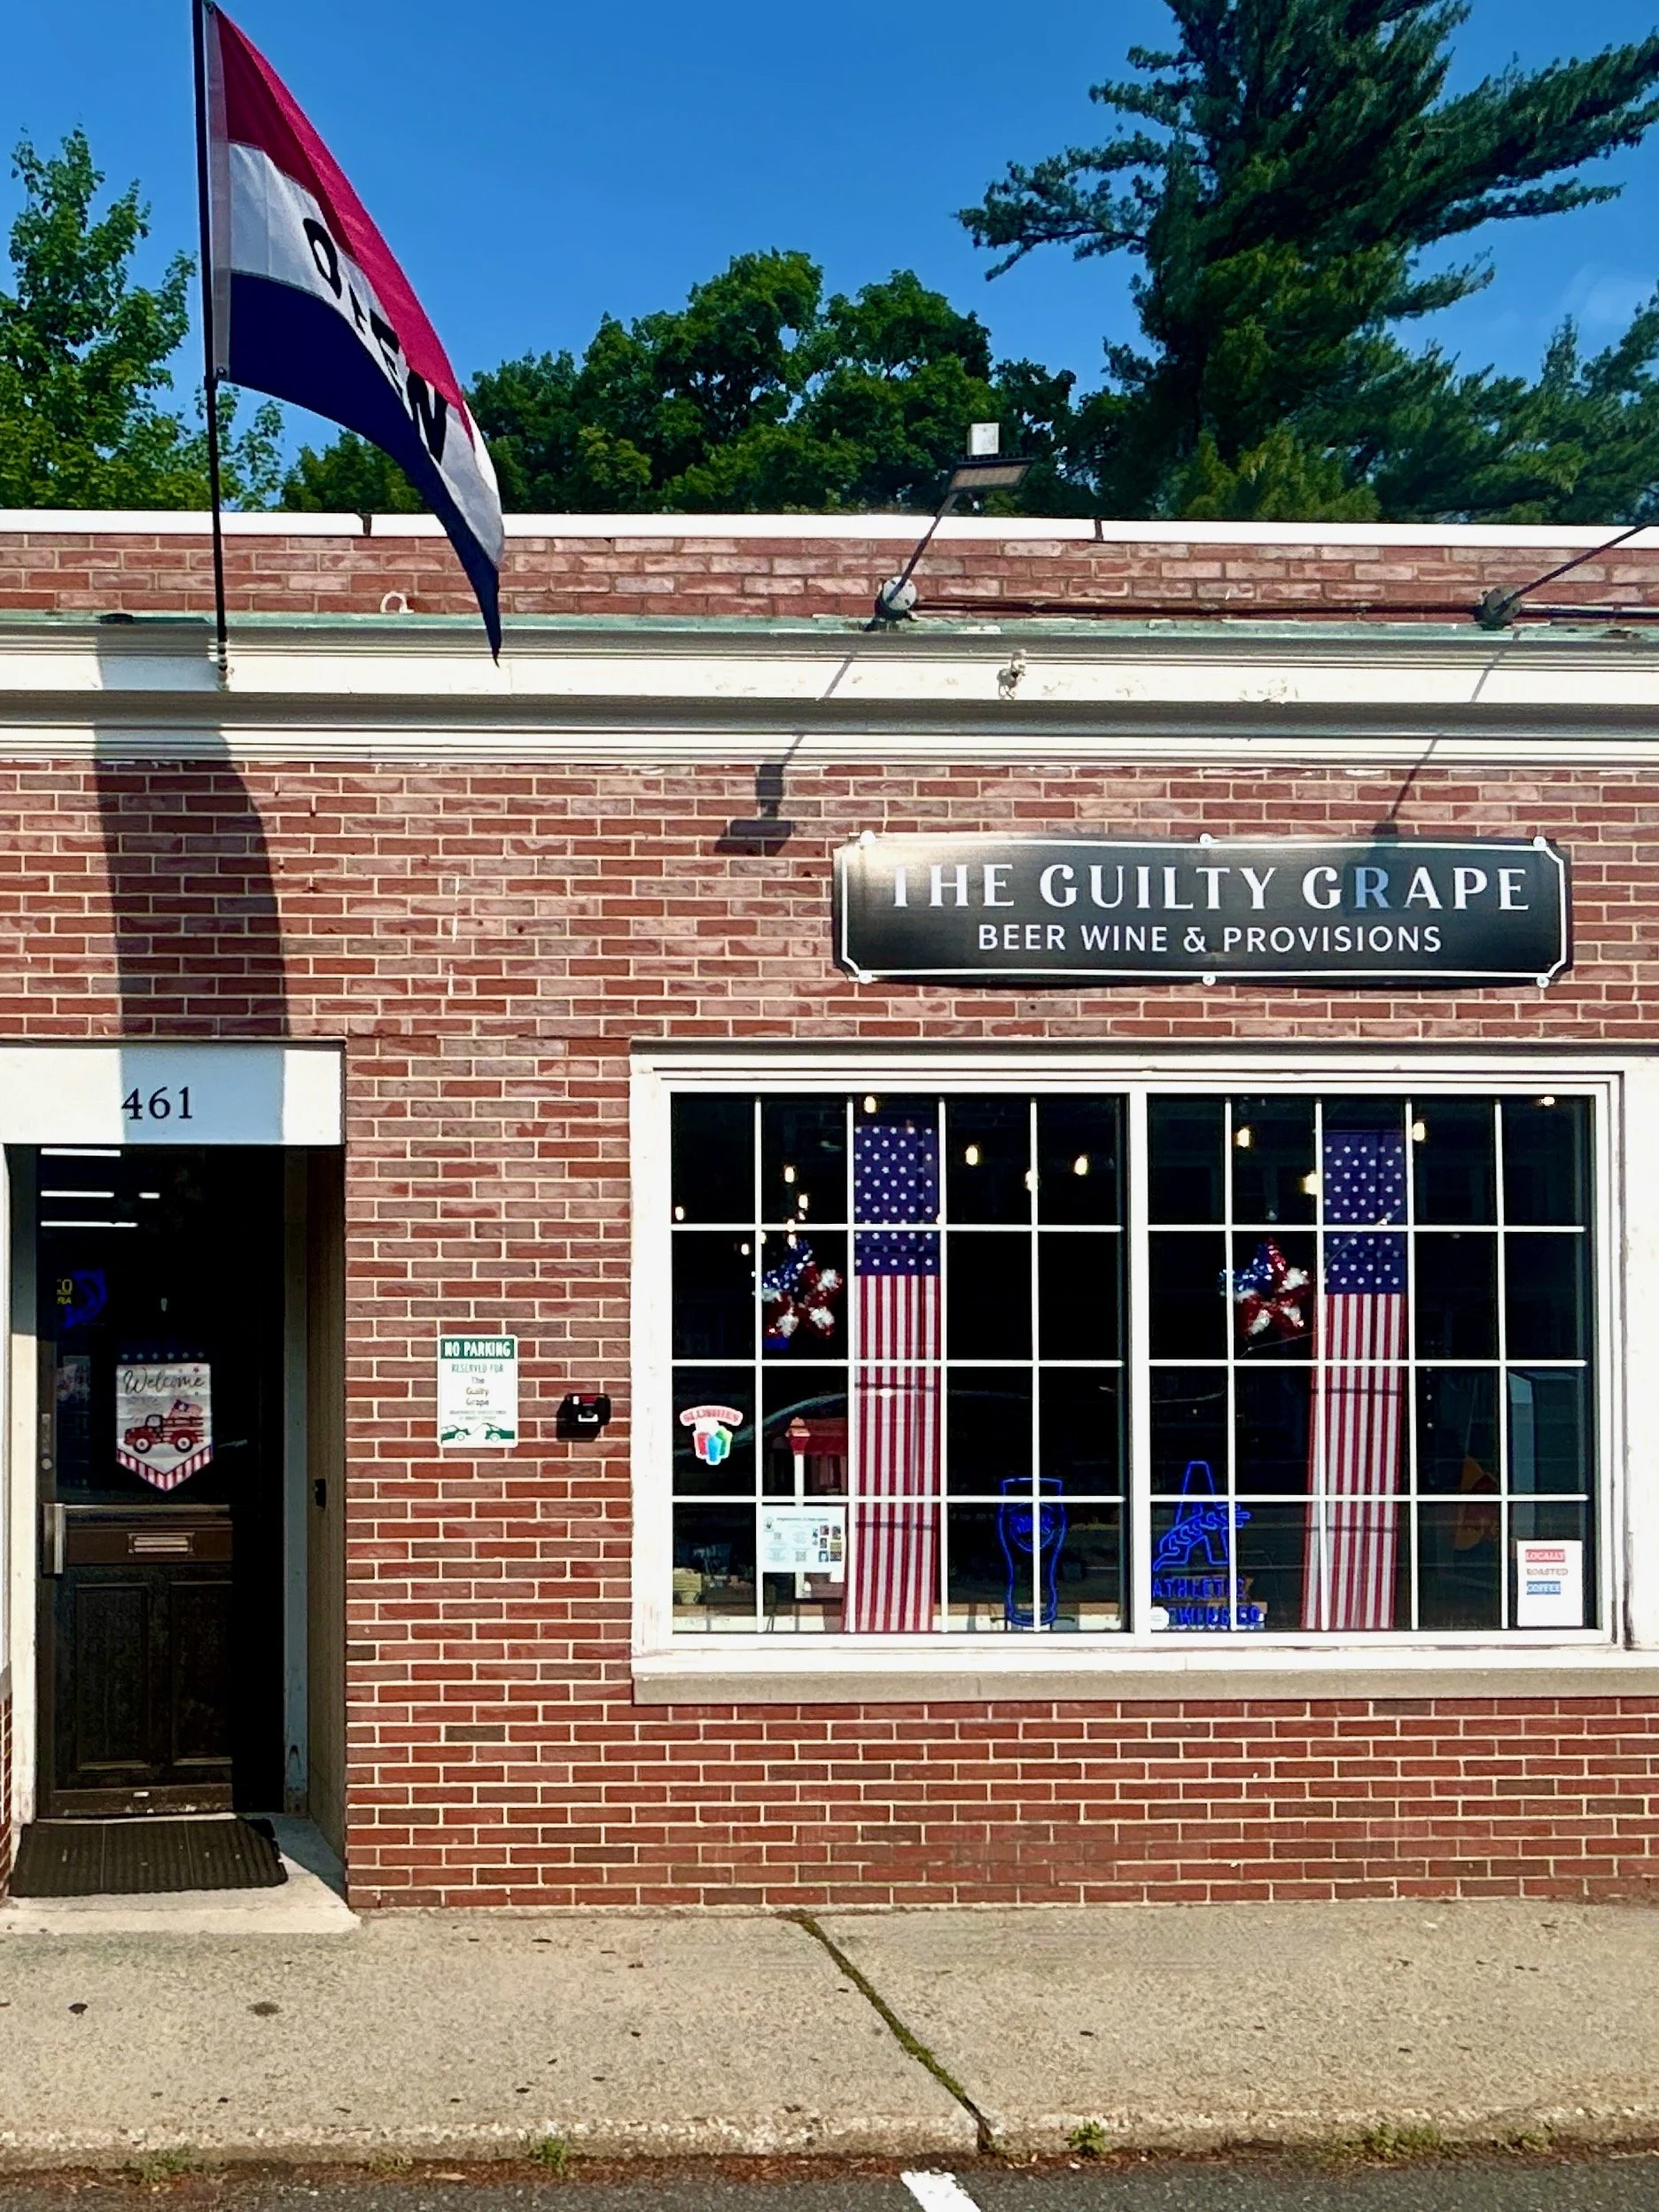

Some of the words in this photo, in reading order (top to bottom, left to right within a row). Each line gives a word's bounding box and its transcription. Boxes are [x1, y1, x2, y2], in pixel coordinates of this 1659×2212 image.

[889, 863, 1016, 908] THE
[1039, 863, 1277, 910] GUILTY
[1301, 866, 1530, 911] GRAPE
[977, 923, 1066, 952] BEER
[1080, 924, 1168, 953] WINE
[1183, 926, 1207, 954] &
[1223, 925, 1443, 954] PROVISIONS
[121, 1086, 193, 1120] 461
[444, 1341, 461, 1358] NO
[463, 1341, 511, 1358] PARKING
[451, 1363, 487, 1374] RESERVED
[489, 1363, 504, 1374] FOR
[123, 1367, 206, 1395] Welcome
[471, 1376, 486, 1385] The
[465, 1398, 490, 1408] Grape
[1151, 1576, 1246, 1599] ATHLETC
